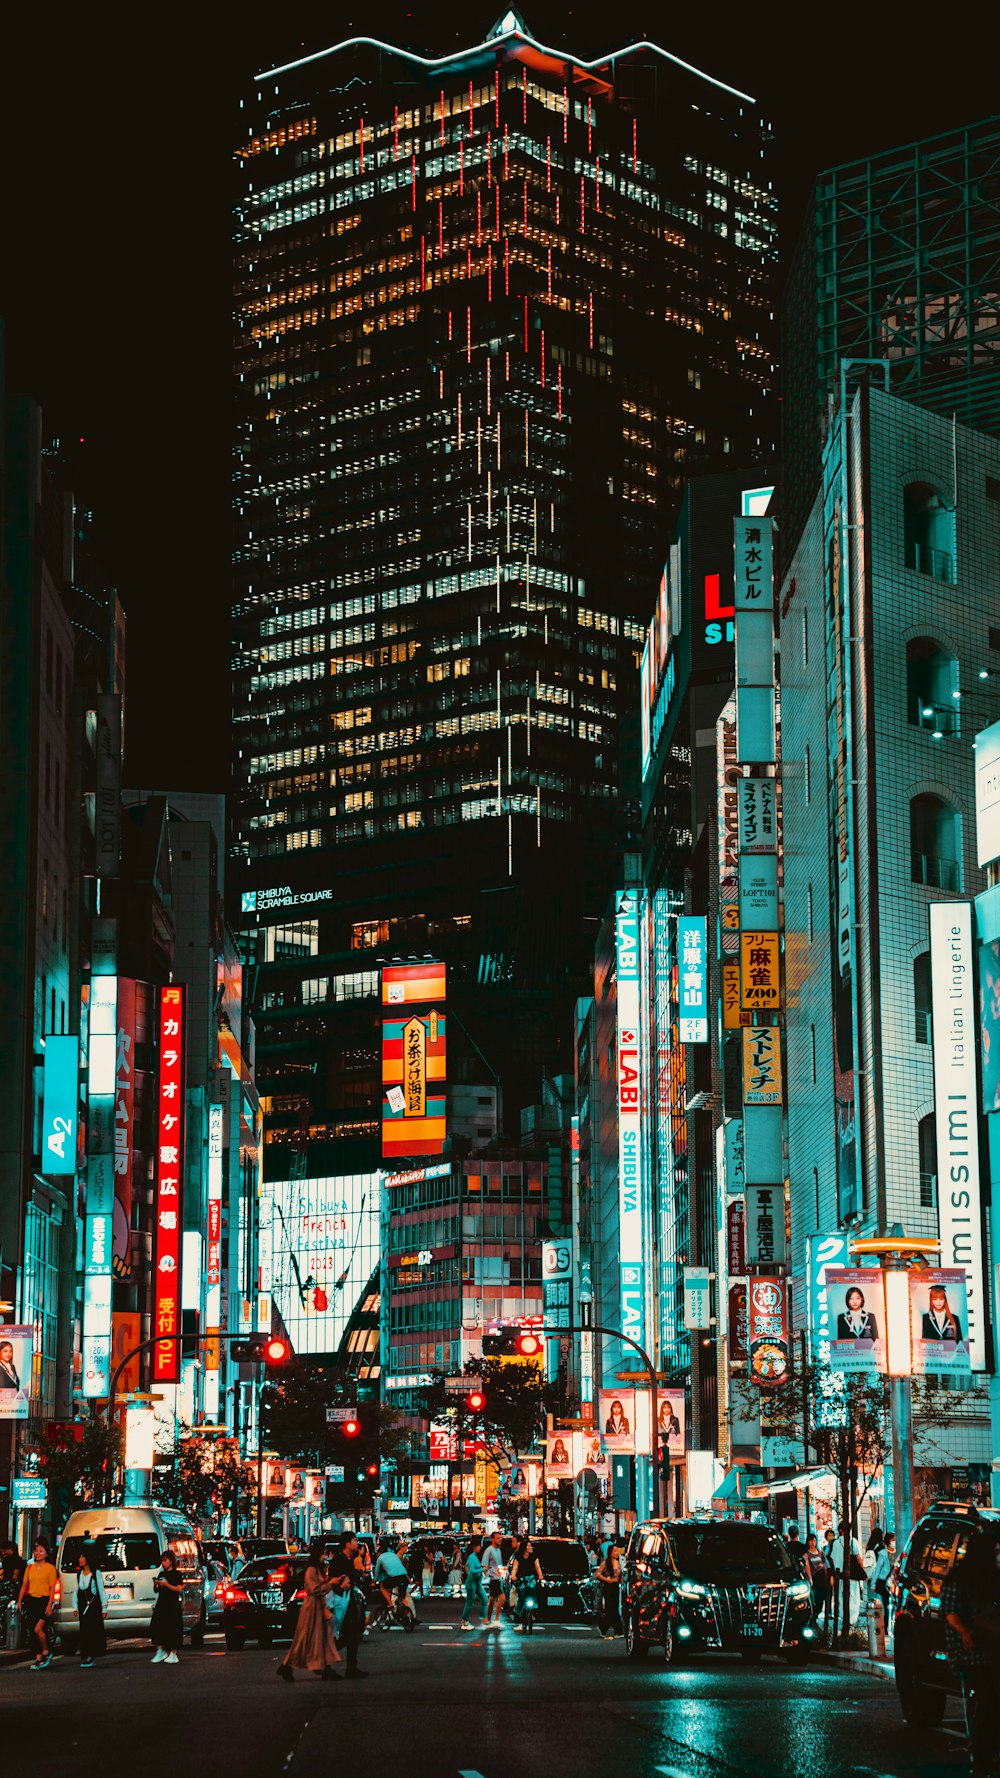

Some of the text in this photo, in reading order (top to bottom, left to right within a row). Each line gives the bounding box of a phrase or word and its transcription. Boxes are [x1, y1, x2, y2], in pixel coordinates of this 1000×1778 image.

[744, 528, 762, 600] 清水ビル
[743, 782, 757, 843] ミスサイゴン
[257, 886, 292, 900] SHIBUYA
[257, 889, 333, 910] SCRAMBLE SQUARE
[743, 889, 776, 897] LOFT101
[618, 918, 637, 976] LABI
[743, 935, 776, 946] フリー
[683, 930, 703, 1006] 洋服の青山
[749, 947, 772, 987] 麻雀
[724, 970, 739, 1010] エステ
[745, 988, 777, 999] ZOO
[751, 1000, 771, 1008] 4F
[949, 926, 965, 1067] Italian lingerie
[687, 1020, 702, 1028] 2F
[687, 1032, 702, 1040] 1F
[749, 1028, 776, 1090] ストレッチ
[620, 1050, 639, 1115] LABI
[47, 1116, 72, 1159] A2
[159, 1018, 180, 1231] カラオケ歌広場
[623, 1131, 637, 1213] SHIBUYA
[299, 1197, 348, 1215] Shibuya
[302, 1213, 347, 1233] French
[756, 1189, 774, 1262] 富士屋酒店
[310, 1256, 333, 1270] 2023
[545, 1246, 569, 1274] OS
[88, 1355, 104, 1364] BAR
[18, 1487, 41, 1495] ステップ
